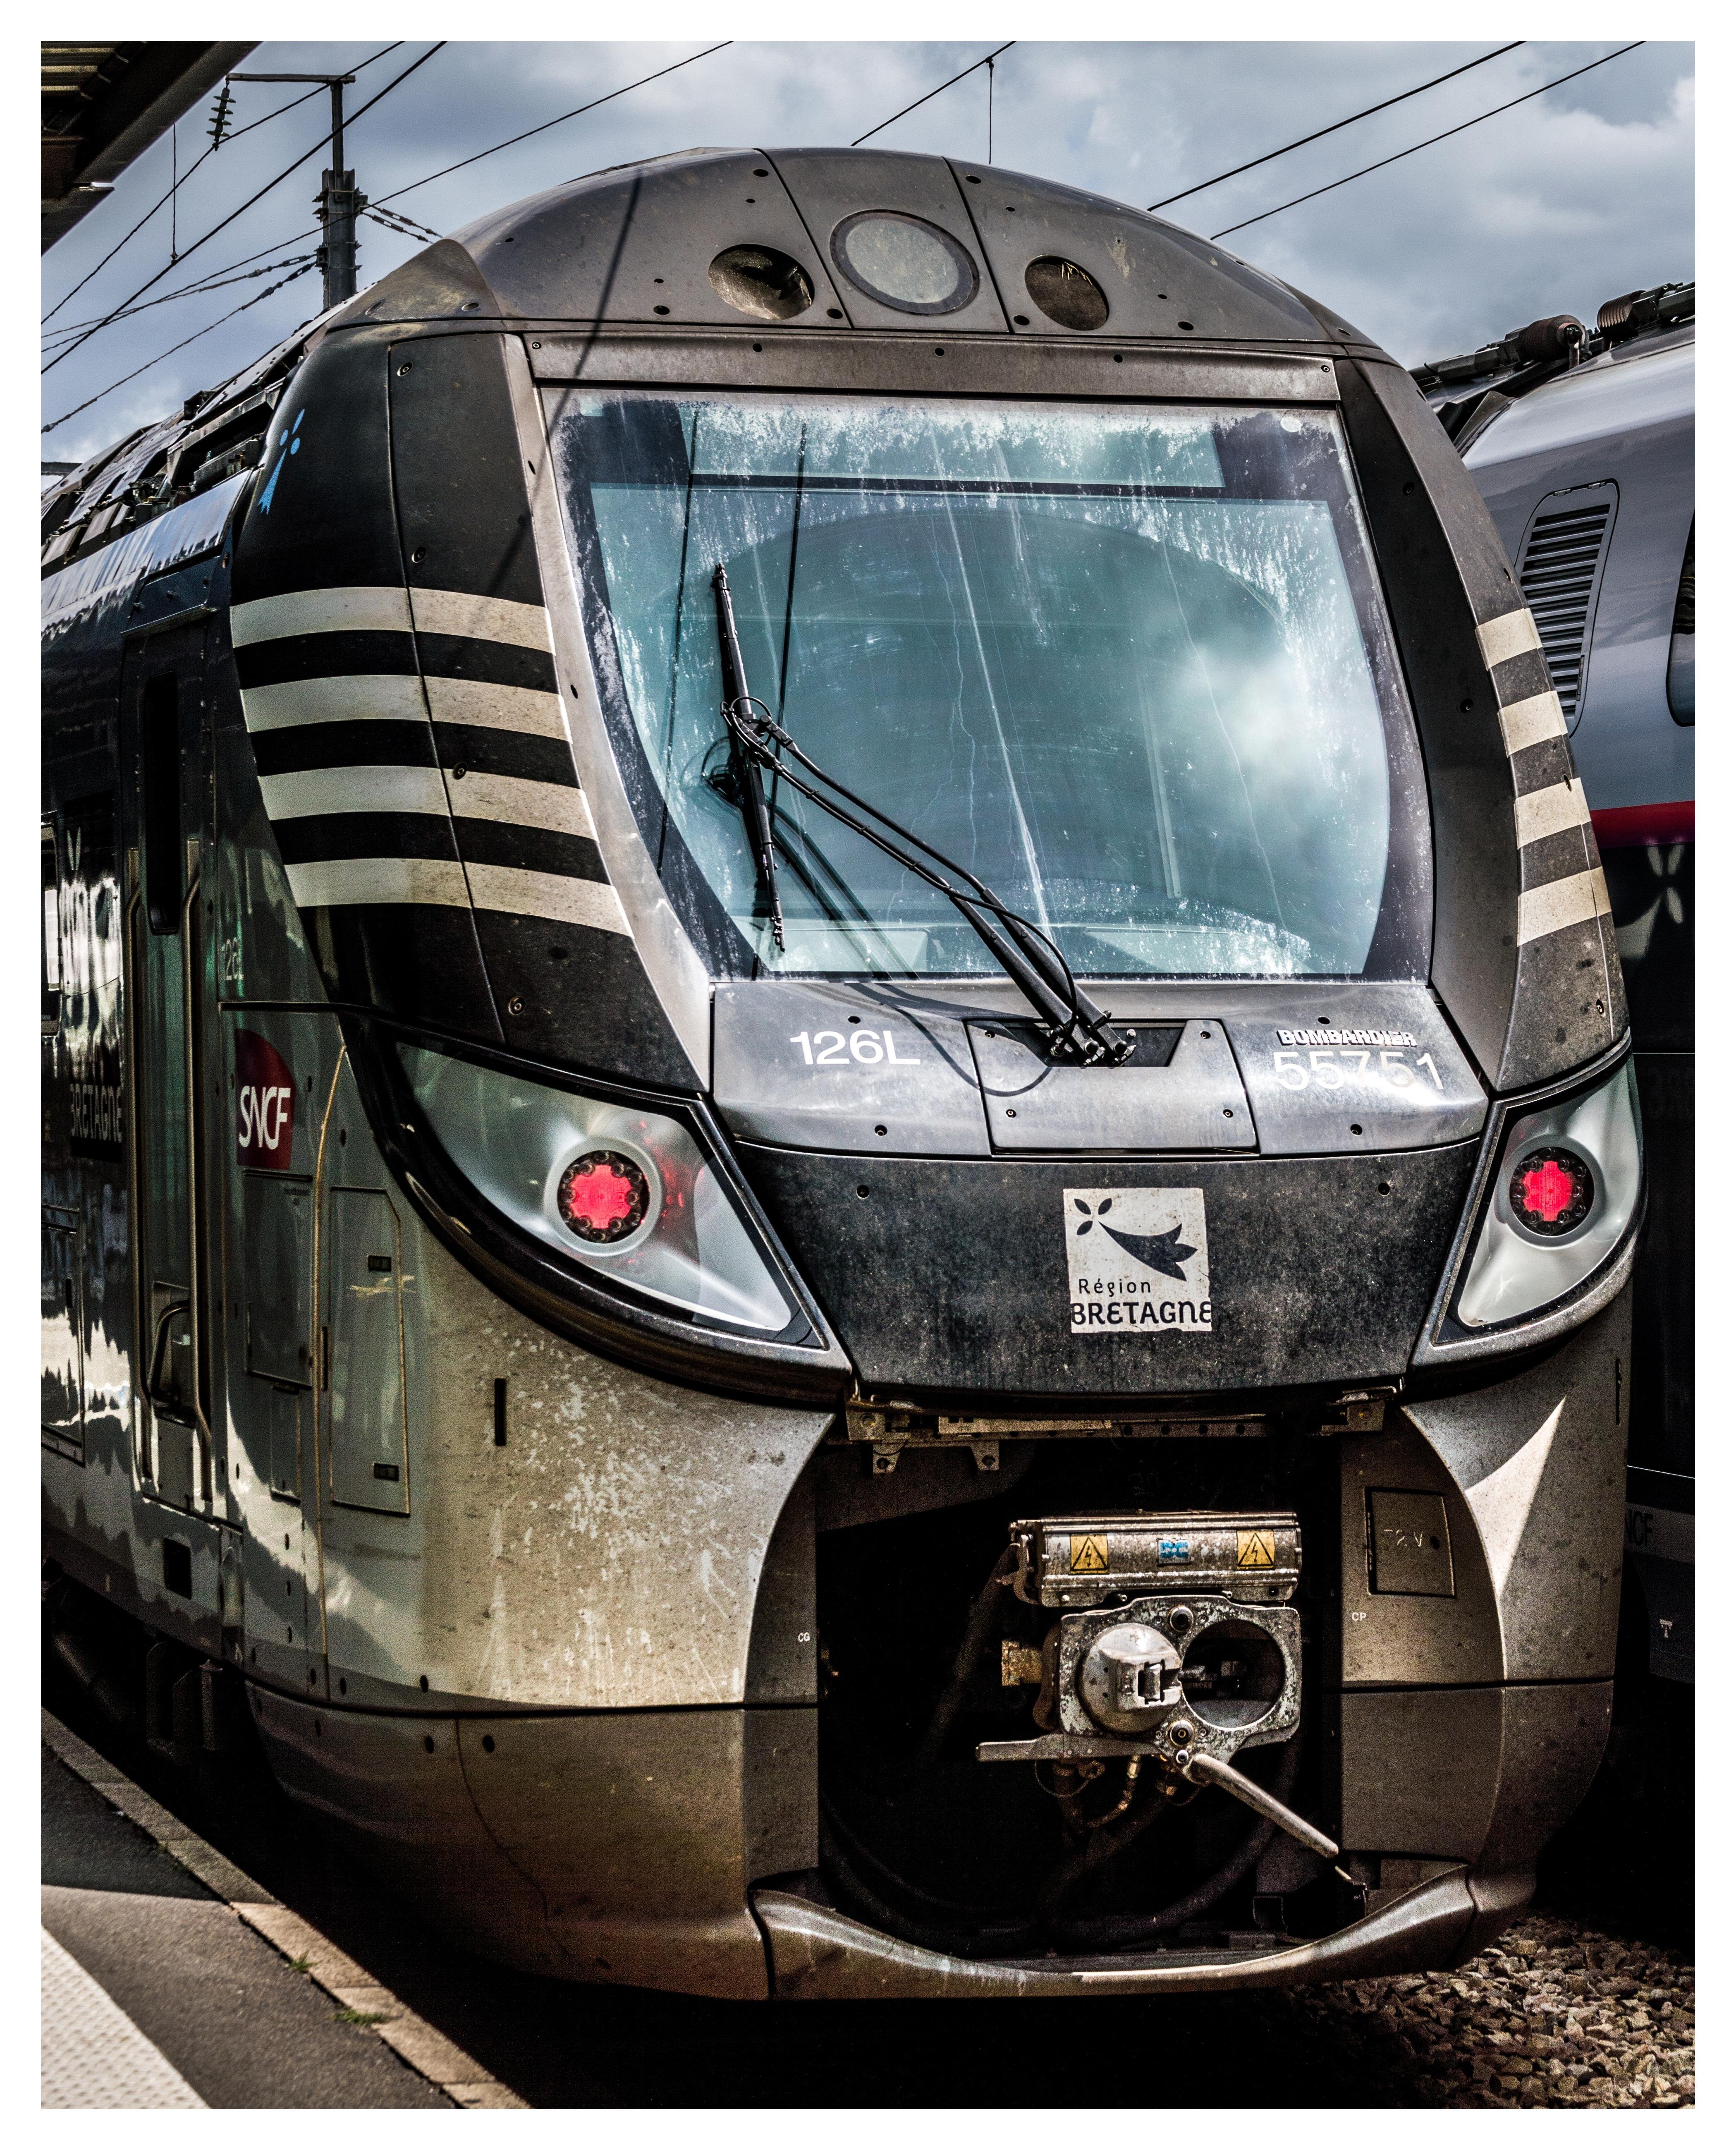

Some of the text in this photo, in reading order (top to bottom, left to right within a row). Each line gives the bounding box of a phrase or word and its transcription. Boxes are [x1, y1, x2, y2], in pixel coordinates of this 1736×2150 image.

[790, 1030, 921, 1065] 126L
[1277, 1030, 1418, 1047] BOMBARDIER
[1273, 1051, 1444, 1091] 55751
[69, 1082, 122, 1143] BRETAGNE
[239, 1085, 292, 1150] SNCF
[1078, 1278, 1151, 1297] Région
[1070, 1300, 1211, 1325] BRETAGNE
[1351, 1612, 1367, 1621] CP
[797, 1632, 810, 1642] CG
